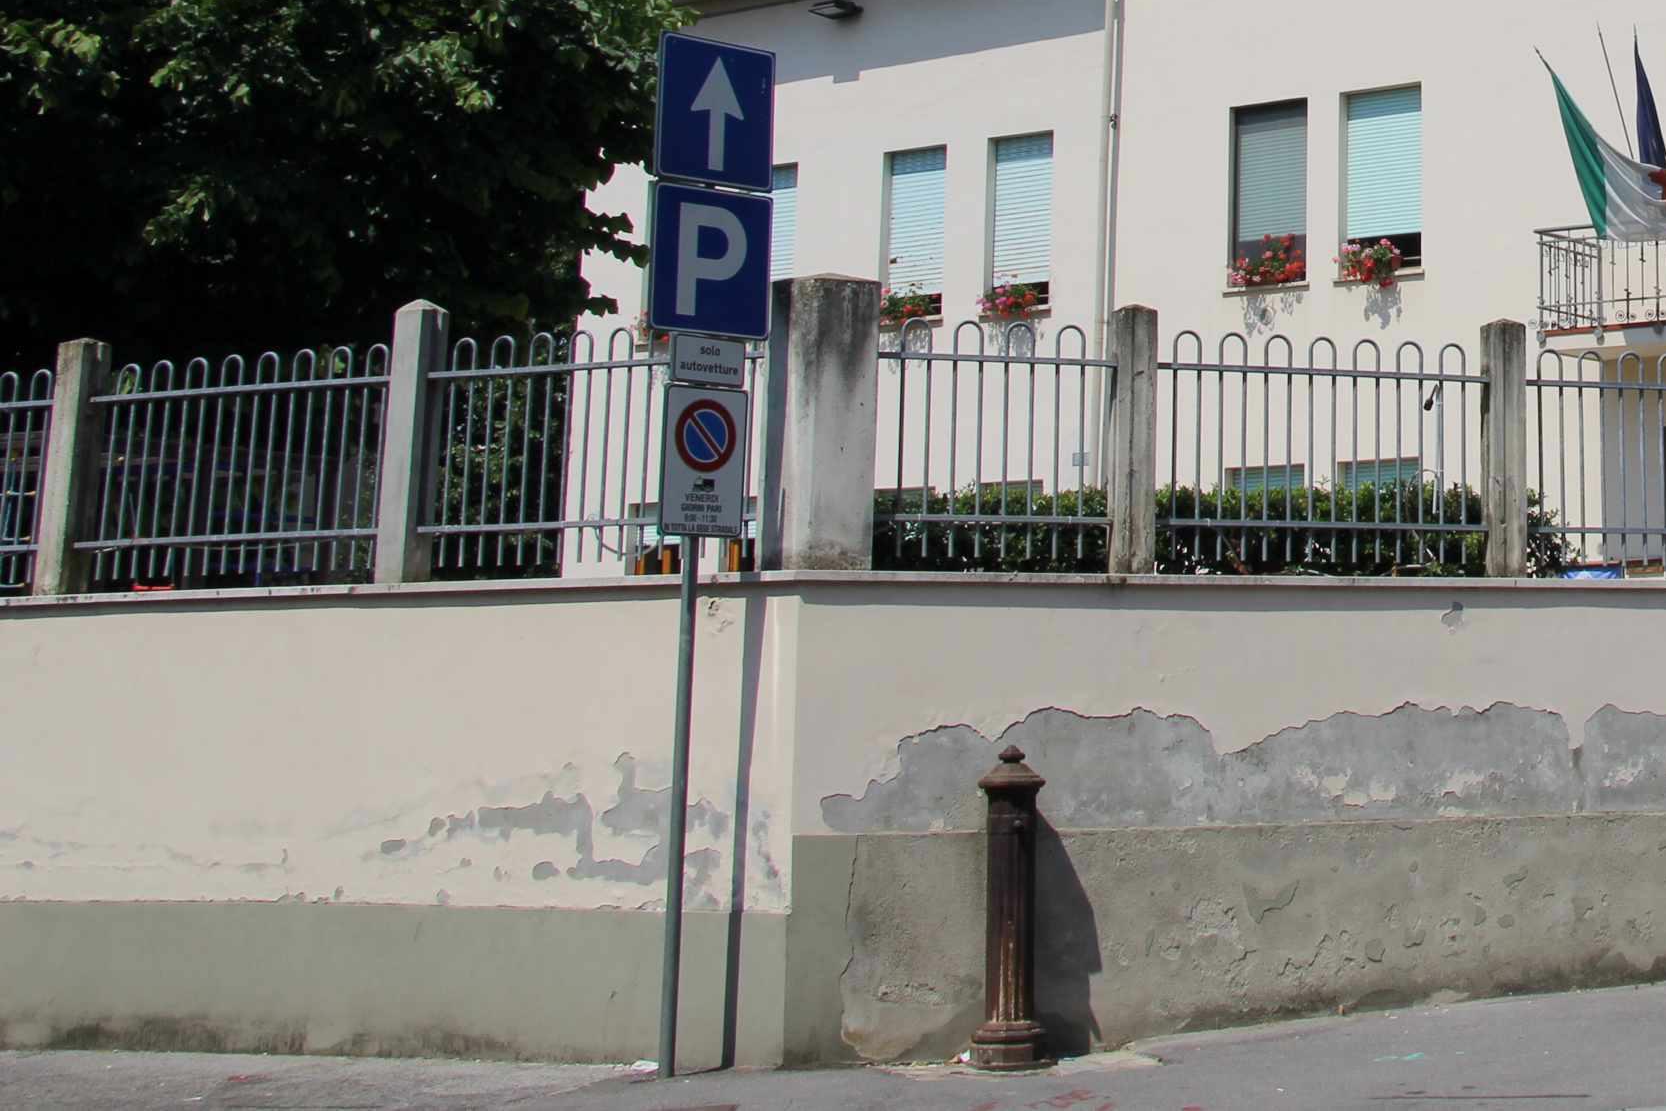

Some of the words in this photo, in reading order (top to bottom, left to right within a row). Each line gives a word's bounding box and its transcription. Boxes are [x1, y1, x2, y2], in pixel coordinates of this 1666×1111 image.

[675, 202, 748, 316] P
[700, 346, 721, 356] solo
[680, 360, 739, 375] autovetture
[706, 504, 722, 513] PARI
